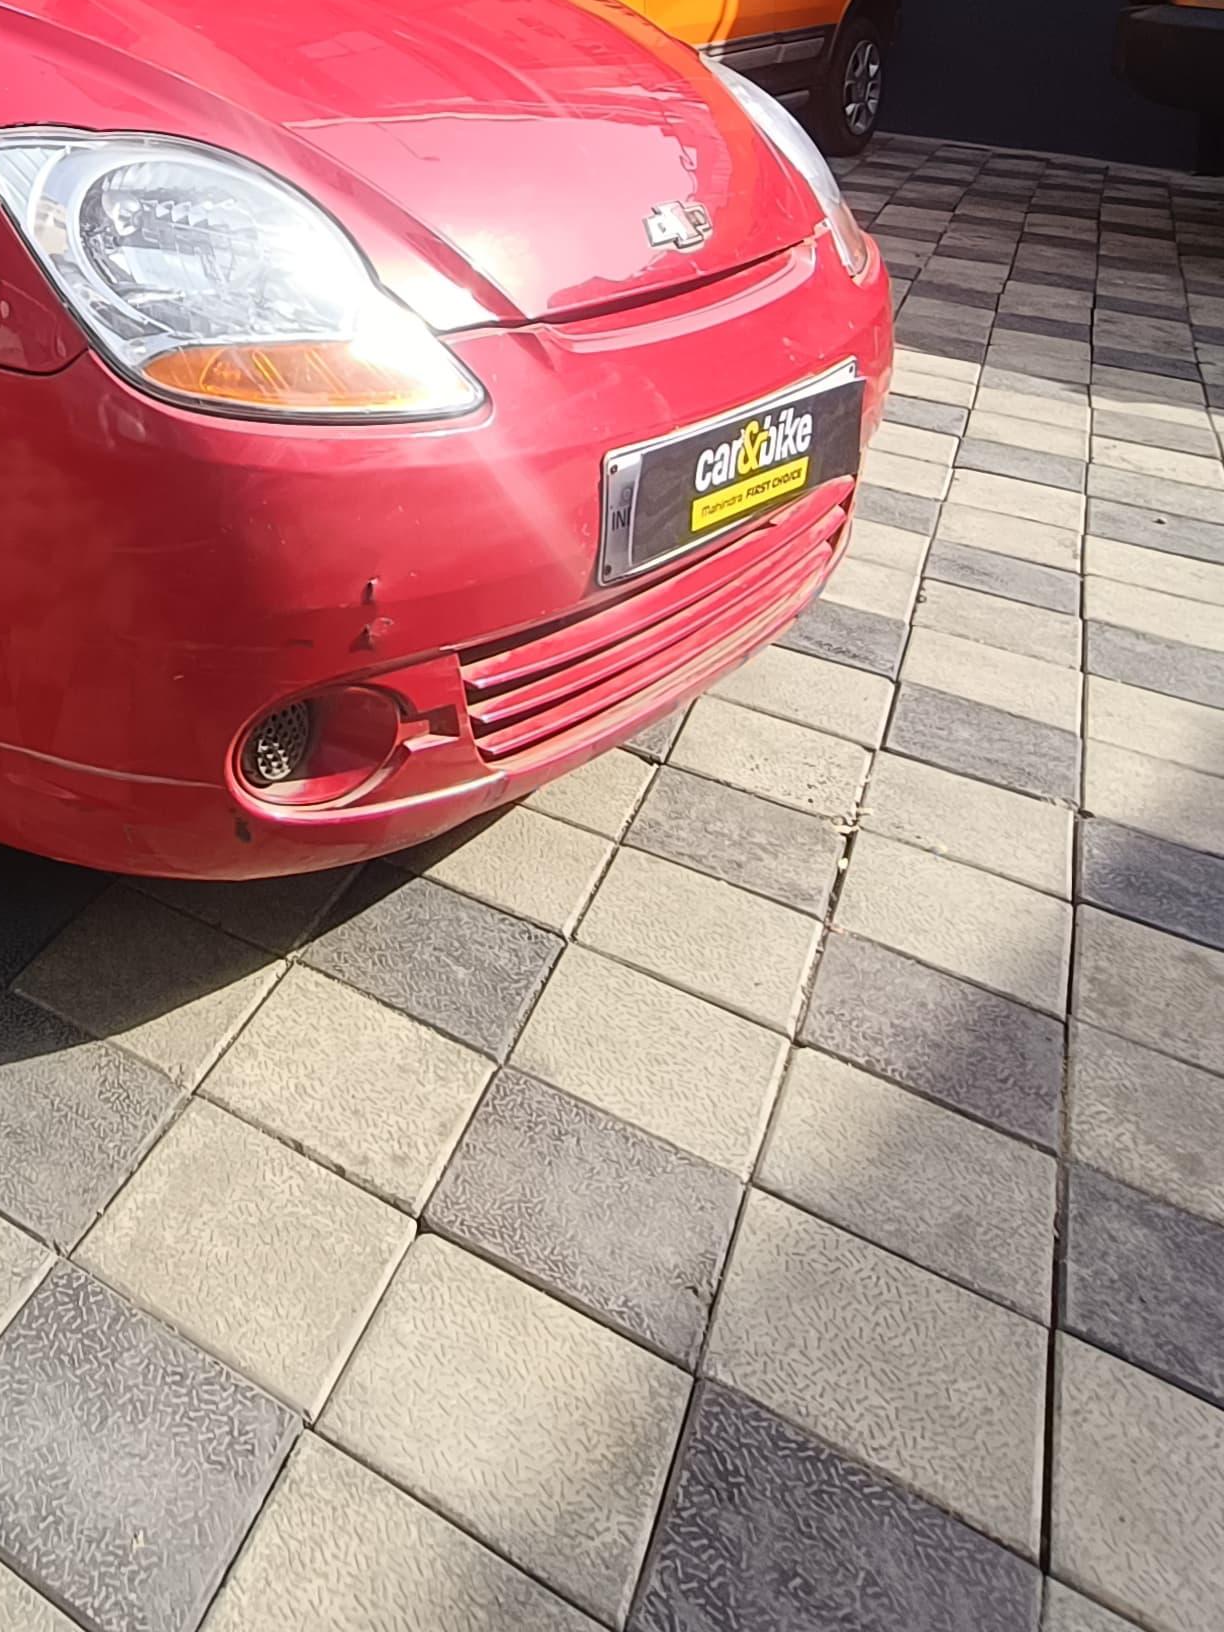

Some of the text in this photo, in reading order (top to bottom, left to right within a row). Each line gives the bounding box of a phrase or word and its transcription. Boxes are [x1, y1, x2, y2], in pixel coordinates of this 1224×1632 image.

[694, 407, 813, 492] car&bike
[701, 467, 803, 518] Mahindra FIRST CHOICE
